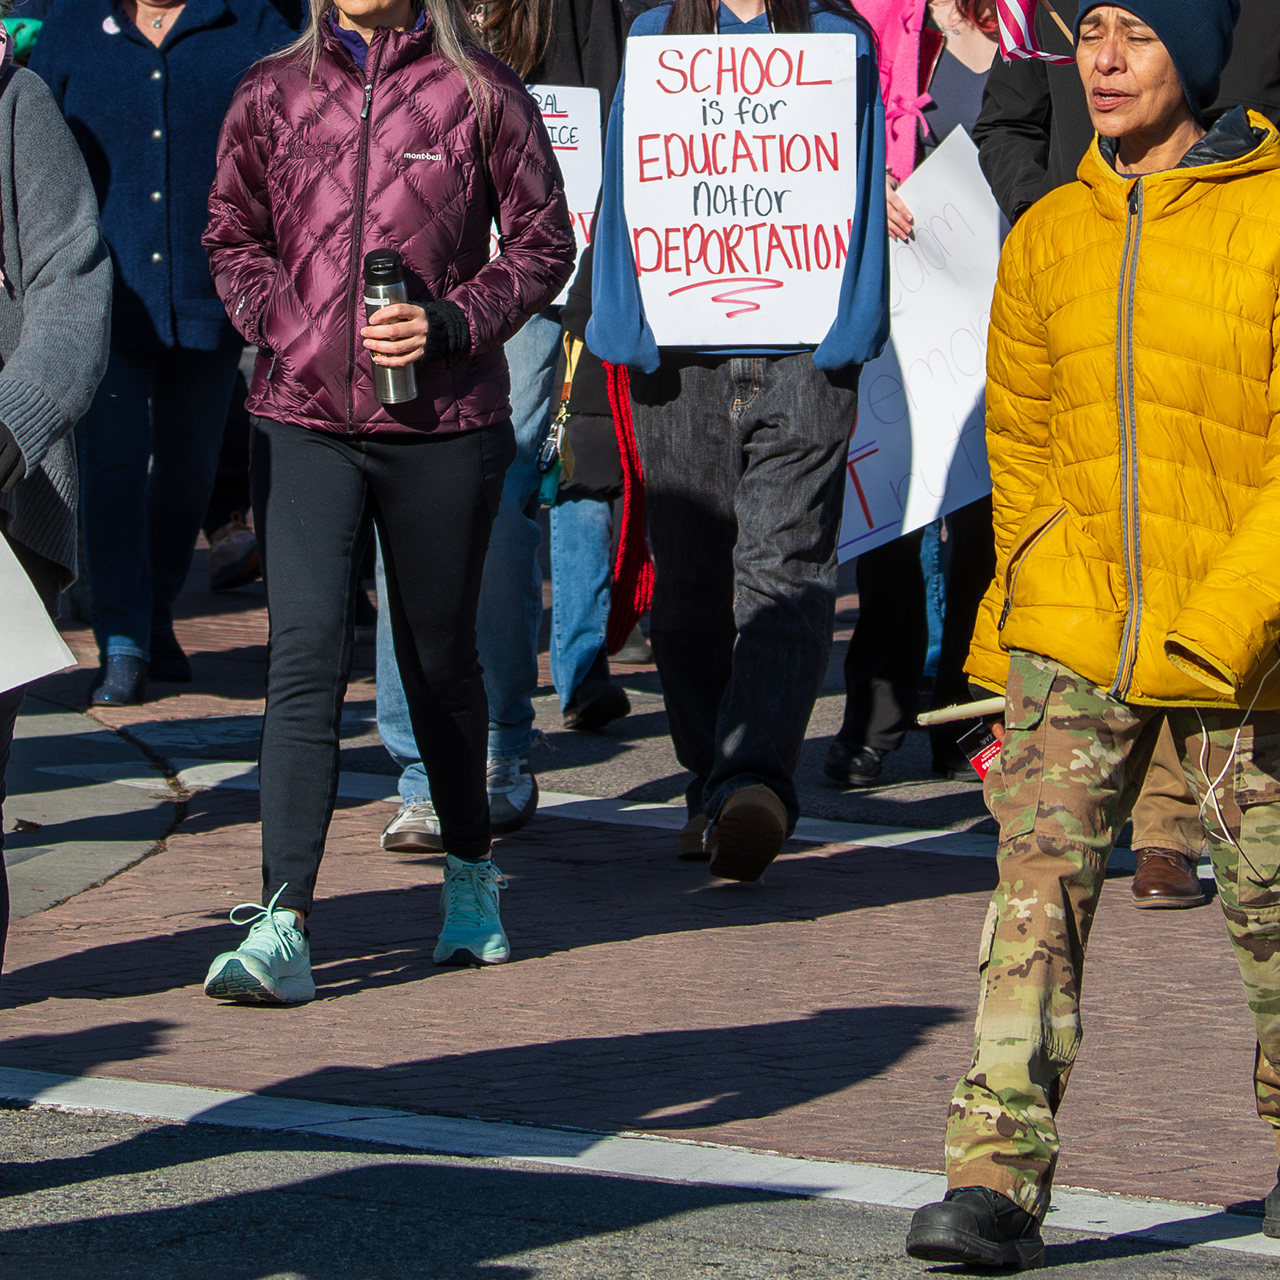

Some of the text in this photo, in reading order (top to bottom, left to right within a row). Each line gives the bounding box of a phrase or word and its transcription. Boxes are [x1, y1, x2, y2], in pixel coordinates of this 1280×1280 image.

[657, 46, 833, 96] SCHOOL
[701, 96, 787, 126] is for
[638, 130, 840, 184] EDUCATION
[633, 219, 852, 278] DEPORTATION
